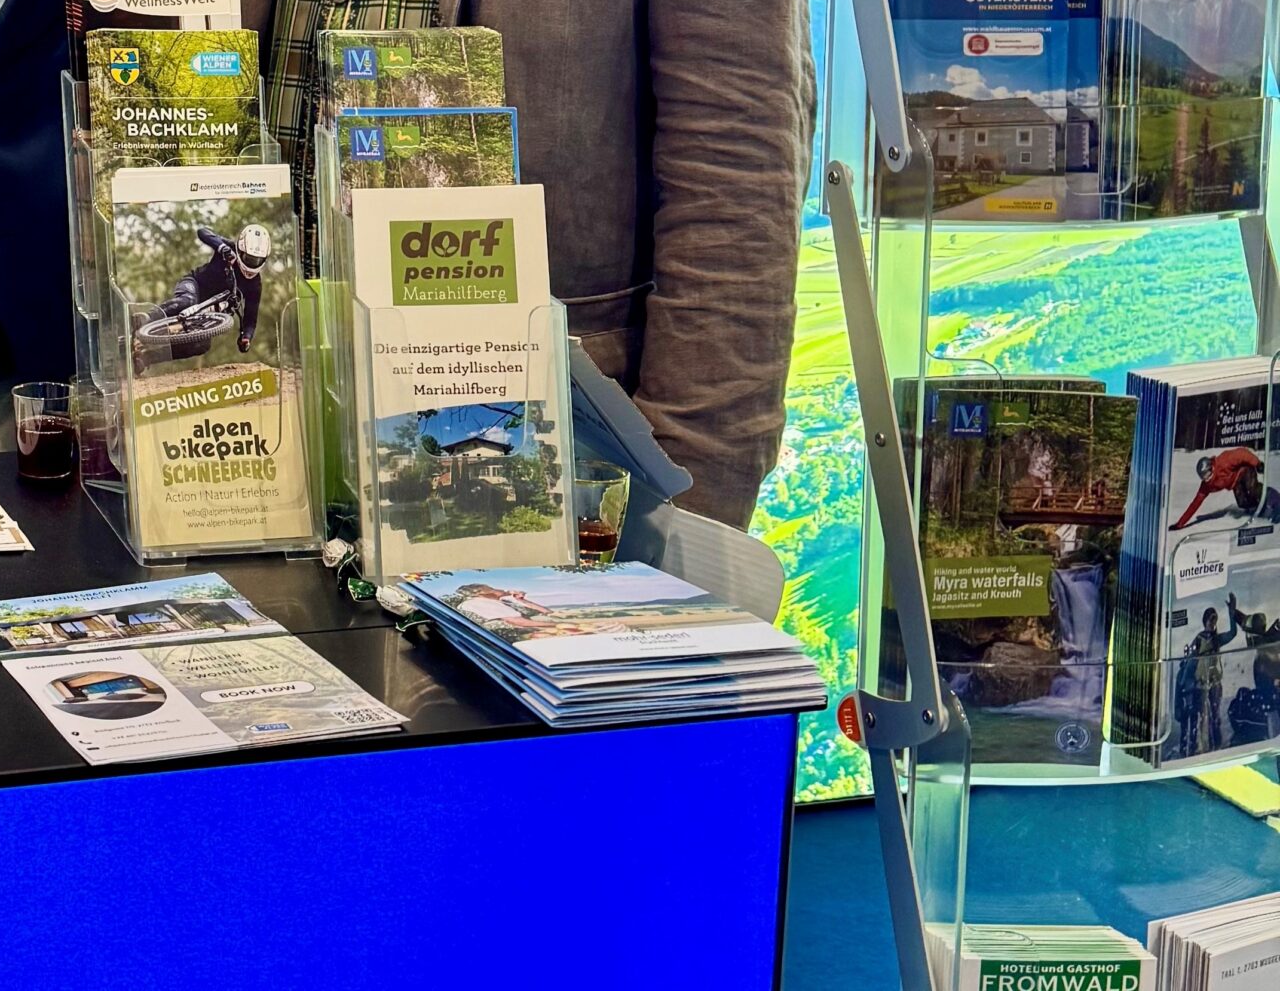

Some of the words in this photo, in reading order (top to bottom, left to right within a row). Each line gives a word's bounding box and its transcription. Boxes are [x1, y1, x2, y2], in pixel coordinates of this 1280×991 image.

[202, 54, 237, 62] WIENER
[203, 61, 232, 69] ALPEN
[112, 107, 214, 121] JOHANNES-
[127, 123, 239, 137] BACHKLAMM
[113, 142, 178, 151] Erlebniswandern
[179, 142, 187, 150] in
[188, 141, 224, 150] Würflach
[400, 220, 504, 259] dorf
[404, 260, 505, 284] pension
[402, 285, 508, 303] Mariahilfberg
[374, 343, 398, 354] Die
[401, 342, 482, 355] einzigartige
[416, 362, 446, 375] dem
[448, 361, 524, 377] idyllischen
[413, 382, 508, 397] Mariahilfberg
[140, 387, 220, 418] OPENING
[221, 378, 264, 401] 2026
[193, 418, 253, 441] alpen
[1234, 421, 1260, 433] Schnee
[162, 434, 270, 461] bikepark
[1220, 435, 1236, 445] vom
[162, 458, 277, 487] SCHNEEBERG
[165, 492, 197, 503] Action
[205, 490, 234, 501] Natur
[241, 487, 280, 499] Erlebnis
[958, 566, 973, 575] and
[974, 567, 994, 575] water
[996, 565, 1017, 574] world
[1179, 562, 1224, 578] unterberg
[934, 575, 968, 593] Myra
[972, 572, 1044, 588] waterfalls
[971, 590, 989, 600] and
[179, 652, 242, 665] WANDERN
[187, 659, 250, 672] WELLNESS
[219, 689, 261, 699] BOOK
[262, 684, 297, 695] NOW
[1040, 963, 1064, 973] und
[1066, 963, 1121, 974] GASTHOF
[981, 974, 1139, 991] FROMWALD
